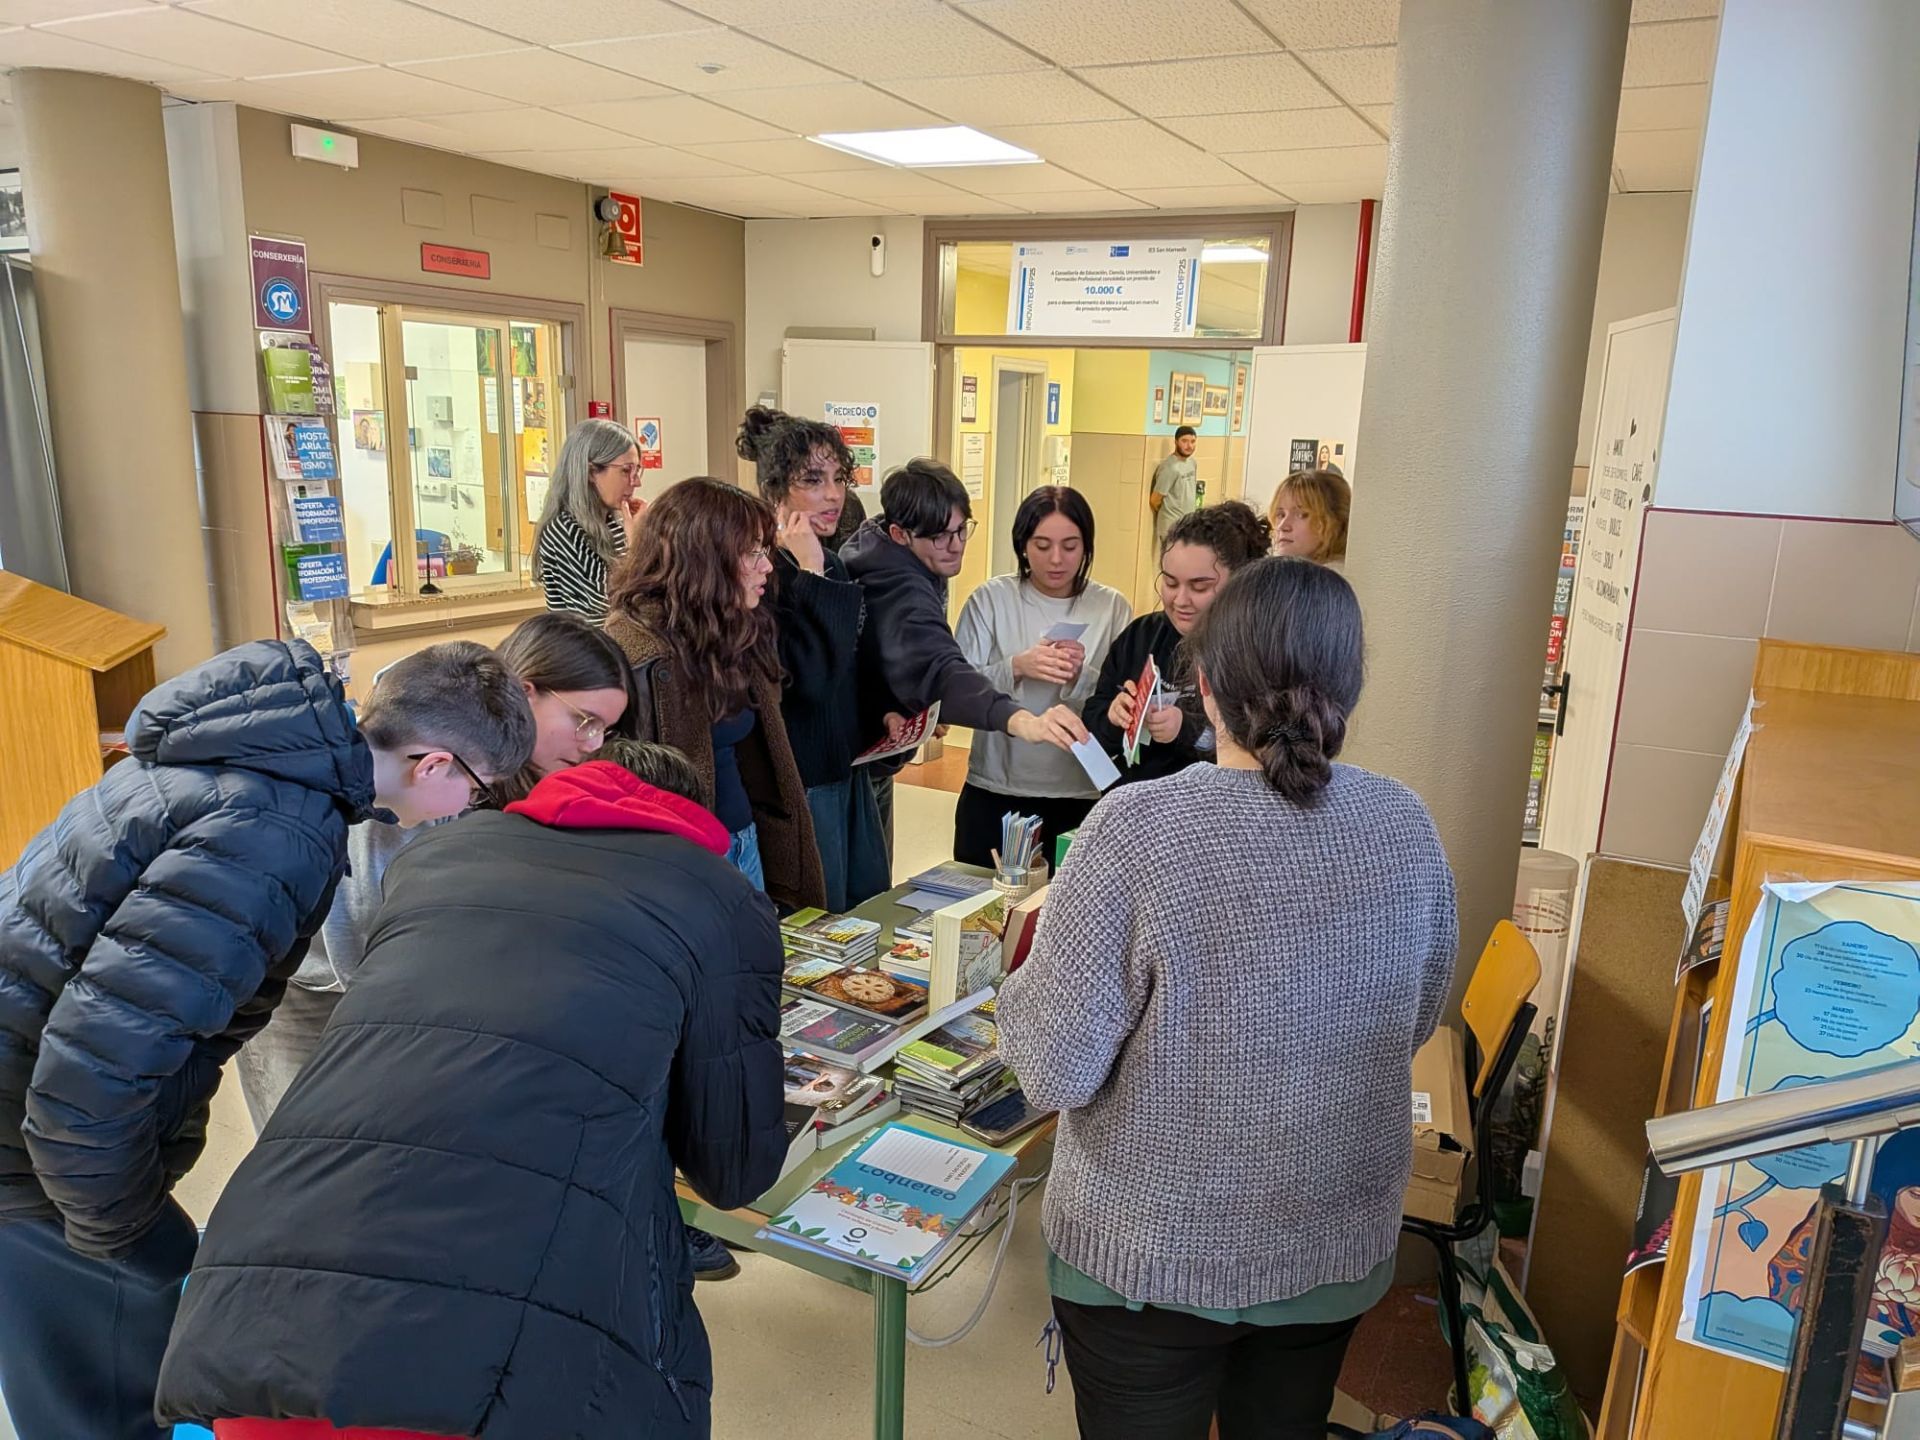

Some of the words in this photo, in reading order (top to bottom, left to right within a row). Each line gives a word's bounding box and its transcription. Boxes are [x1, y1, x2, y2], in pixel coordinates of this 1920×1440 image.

[253, 250, 304, 264] CONSERXERÍA
[1085, 286, 1114, 294] 10.000
[1026, 267, 1036, 331] INNOVATECHFP25
[1173, 258, 1187, 333] INNOVATECHFP25
[834, 407, 866, 416] RECREOS
[299, 432, 329, 441] HOSTA
[300, 502, 324, 510] OFERTA
[301, 509, 337, 517] FORMACIÓN
[300, 561, 323, 569] OFERTA
[300, 568, 334, 577] FORMACIÓN
[1831, 1006, 1854, 1014] MARZO
[858, 1164, 957, 1200] Loqueleo
